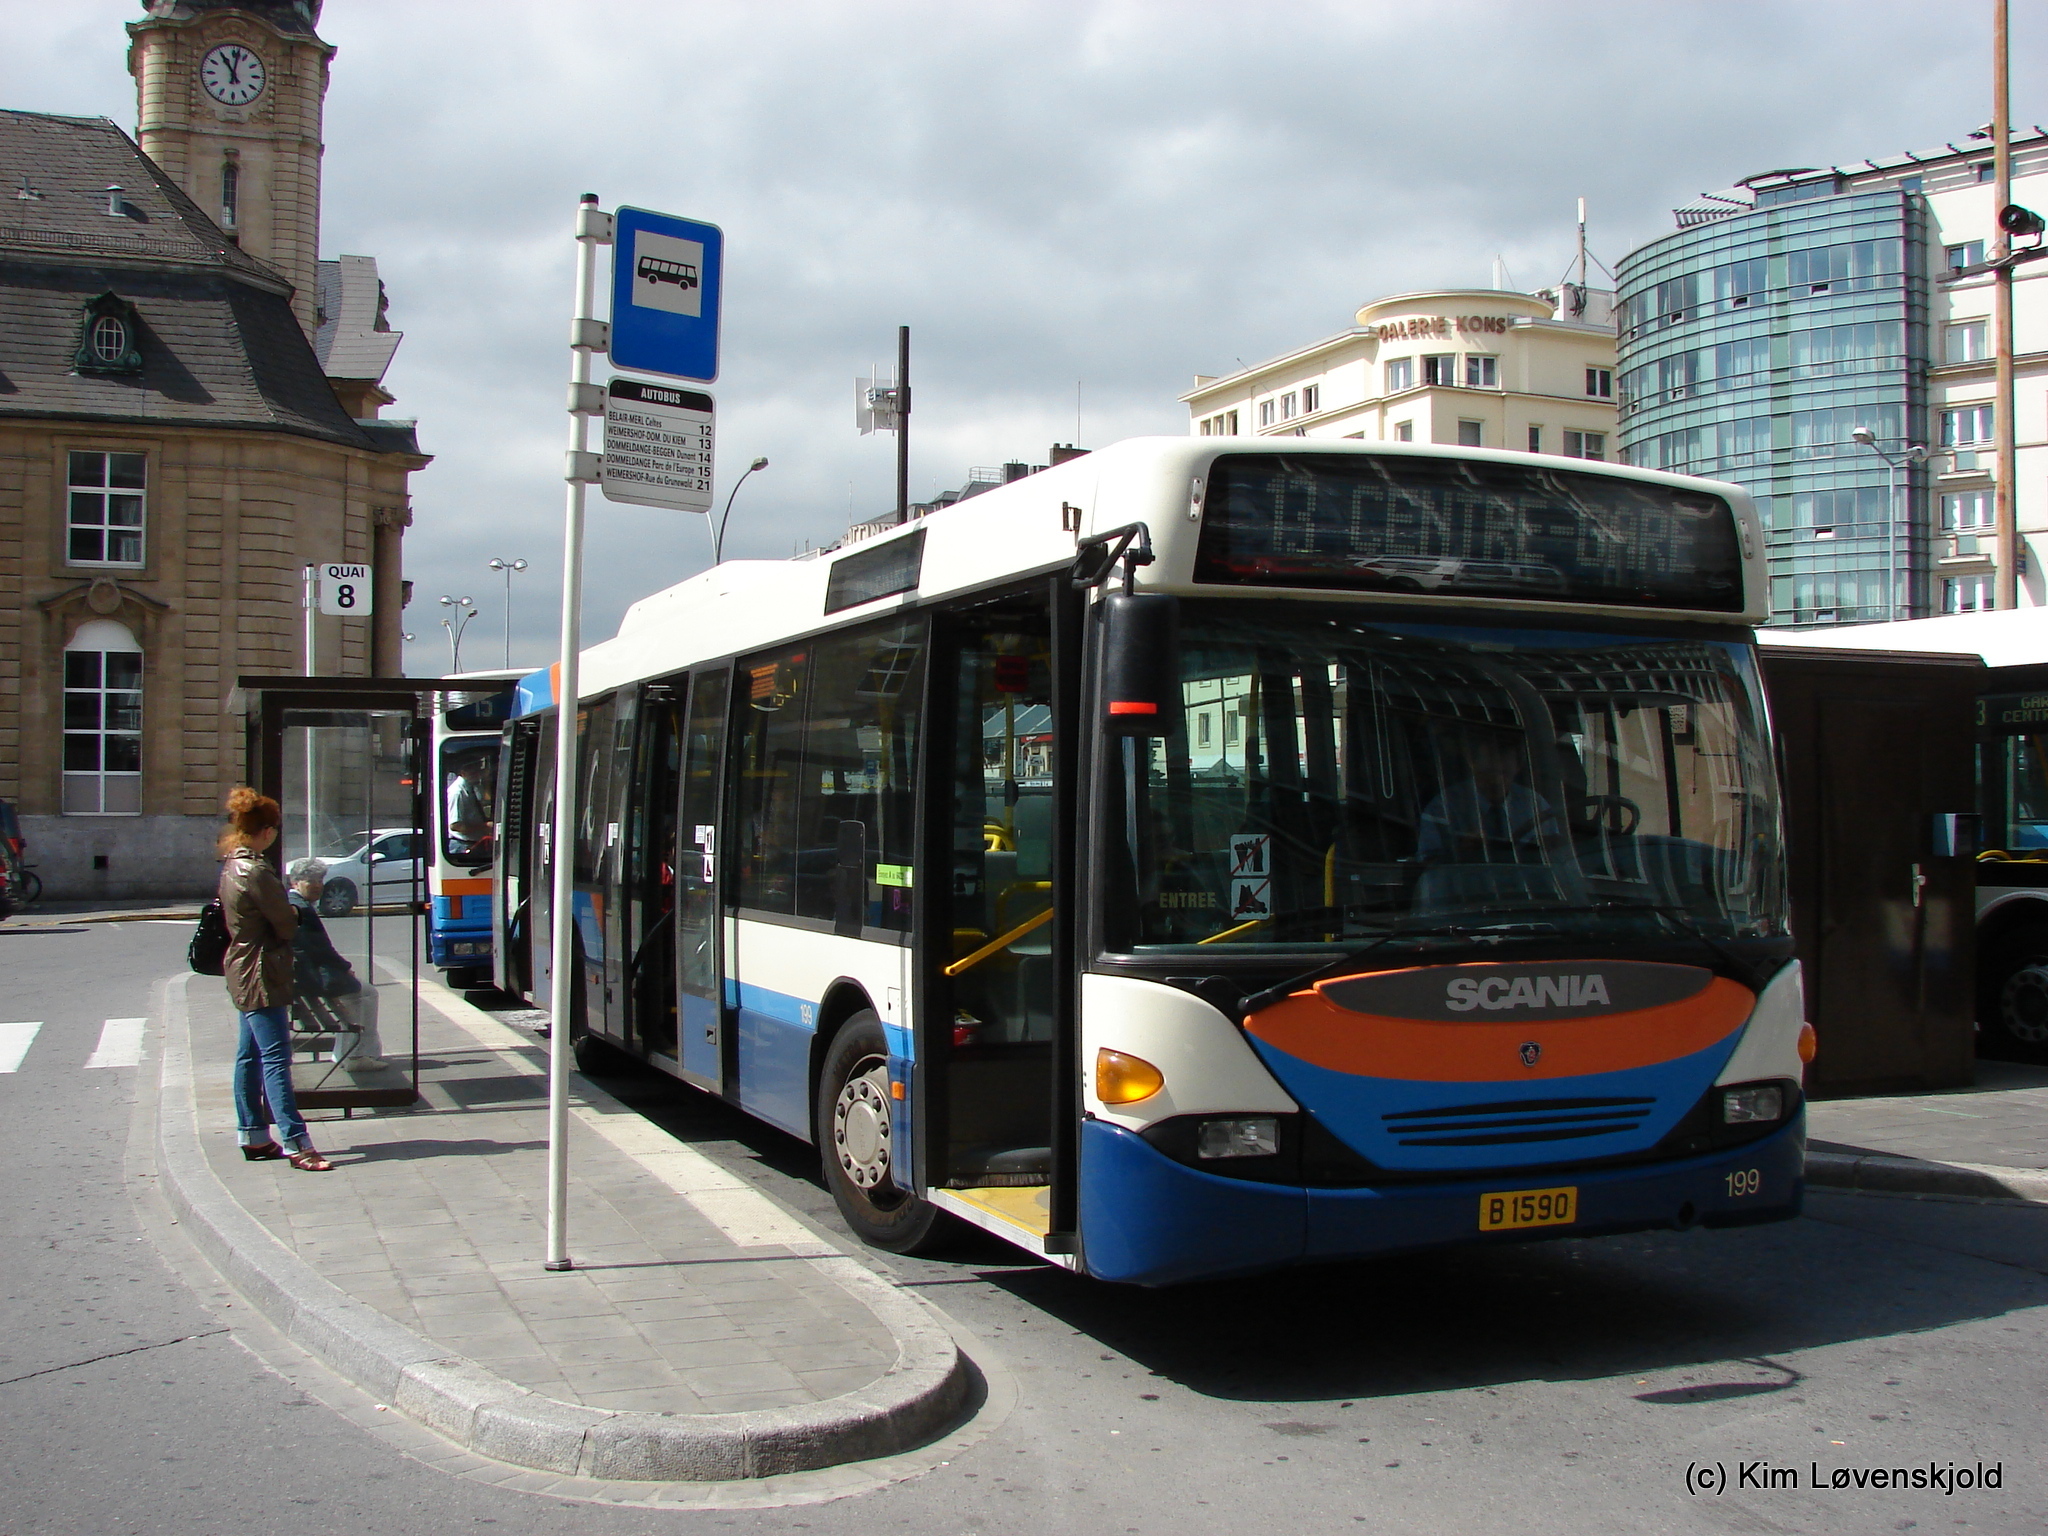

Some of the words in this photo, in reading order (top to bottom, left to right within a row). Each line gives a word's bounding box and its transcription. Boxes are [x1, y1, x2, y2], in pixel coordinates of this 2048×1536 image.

[1377, 316, 1446, 341] GALERIE
[1456, 315, 1506, 334] KONS
[640, 387, 681, 404] AUTOBUS
[608, 410, 644, 426] BELAIR-MERL
[699, 424, 712, 437] 12
[662, 433, 672, 444] DU
[672, 435, 686, 446] KIEM
[698, 438, 712, 450] 13
[606, 453, 651, 469] DOMMELDANGE
[652, 459, 664, 471] Parc
[665, 461, 672, 472] de
[698, 466, 711, 478] 15
[698, 452, 711, 464] 14
[656, 474, 664, 485] du
[697, 479, 710, 491] 21
[1266, 473, 1317, 553] 13
[328, 565, 364, 580] QUAI
[337, 584, 355, 608] 8
[1160, 891, 1216, 908] ENTREE
[1445, 974, 1611, 1012] SCANIA
[800, 1003, 813, 1026] 199
[1725, 1168, 1770, 1197] 199
[1489, 1198, 1504, 1225] B
[1511, 1193, 1569, 1223] 1590
